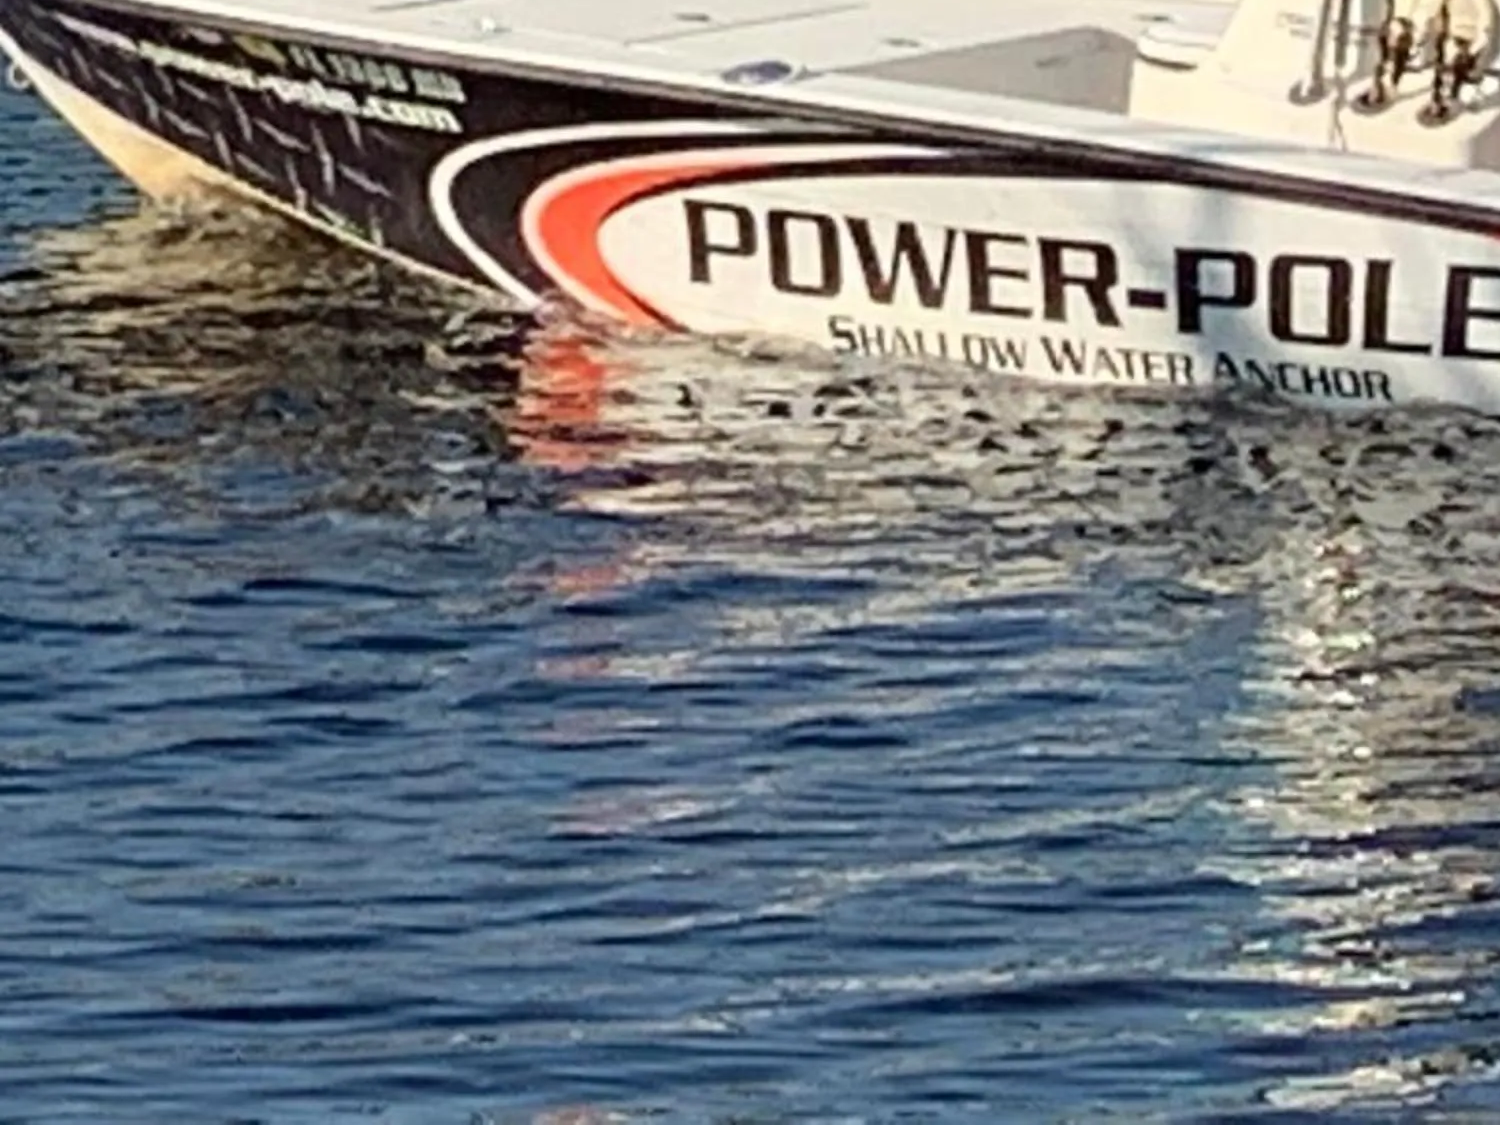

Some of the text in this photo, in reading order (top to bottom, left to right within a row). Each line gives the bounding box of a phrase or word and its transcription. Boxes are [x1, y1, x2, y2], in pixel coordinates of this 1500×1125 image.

[827, 314, 1394, 402] SHALLOW WATER ANCHOR
